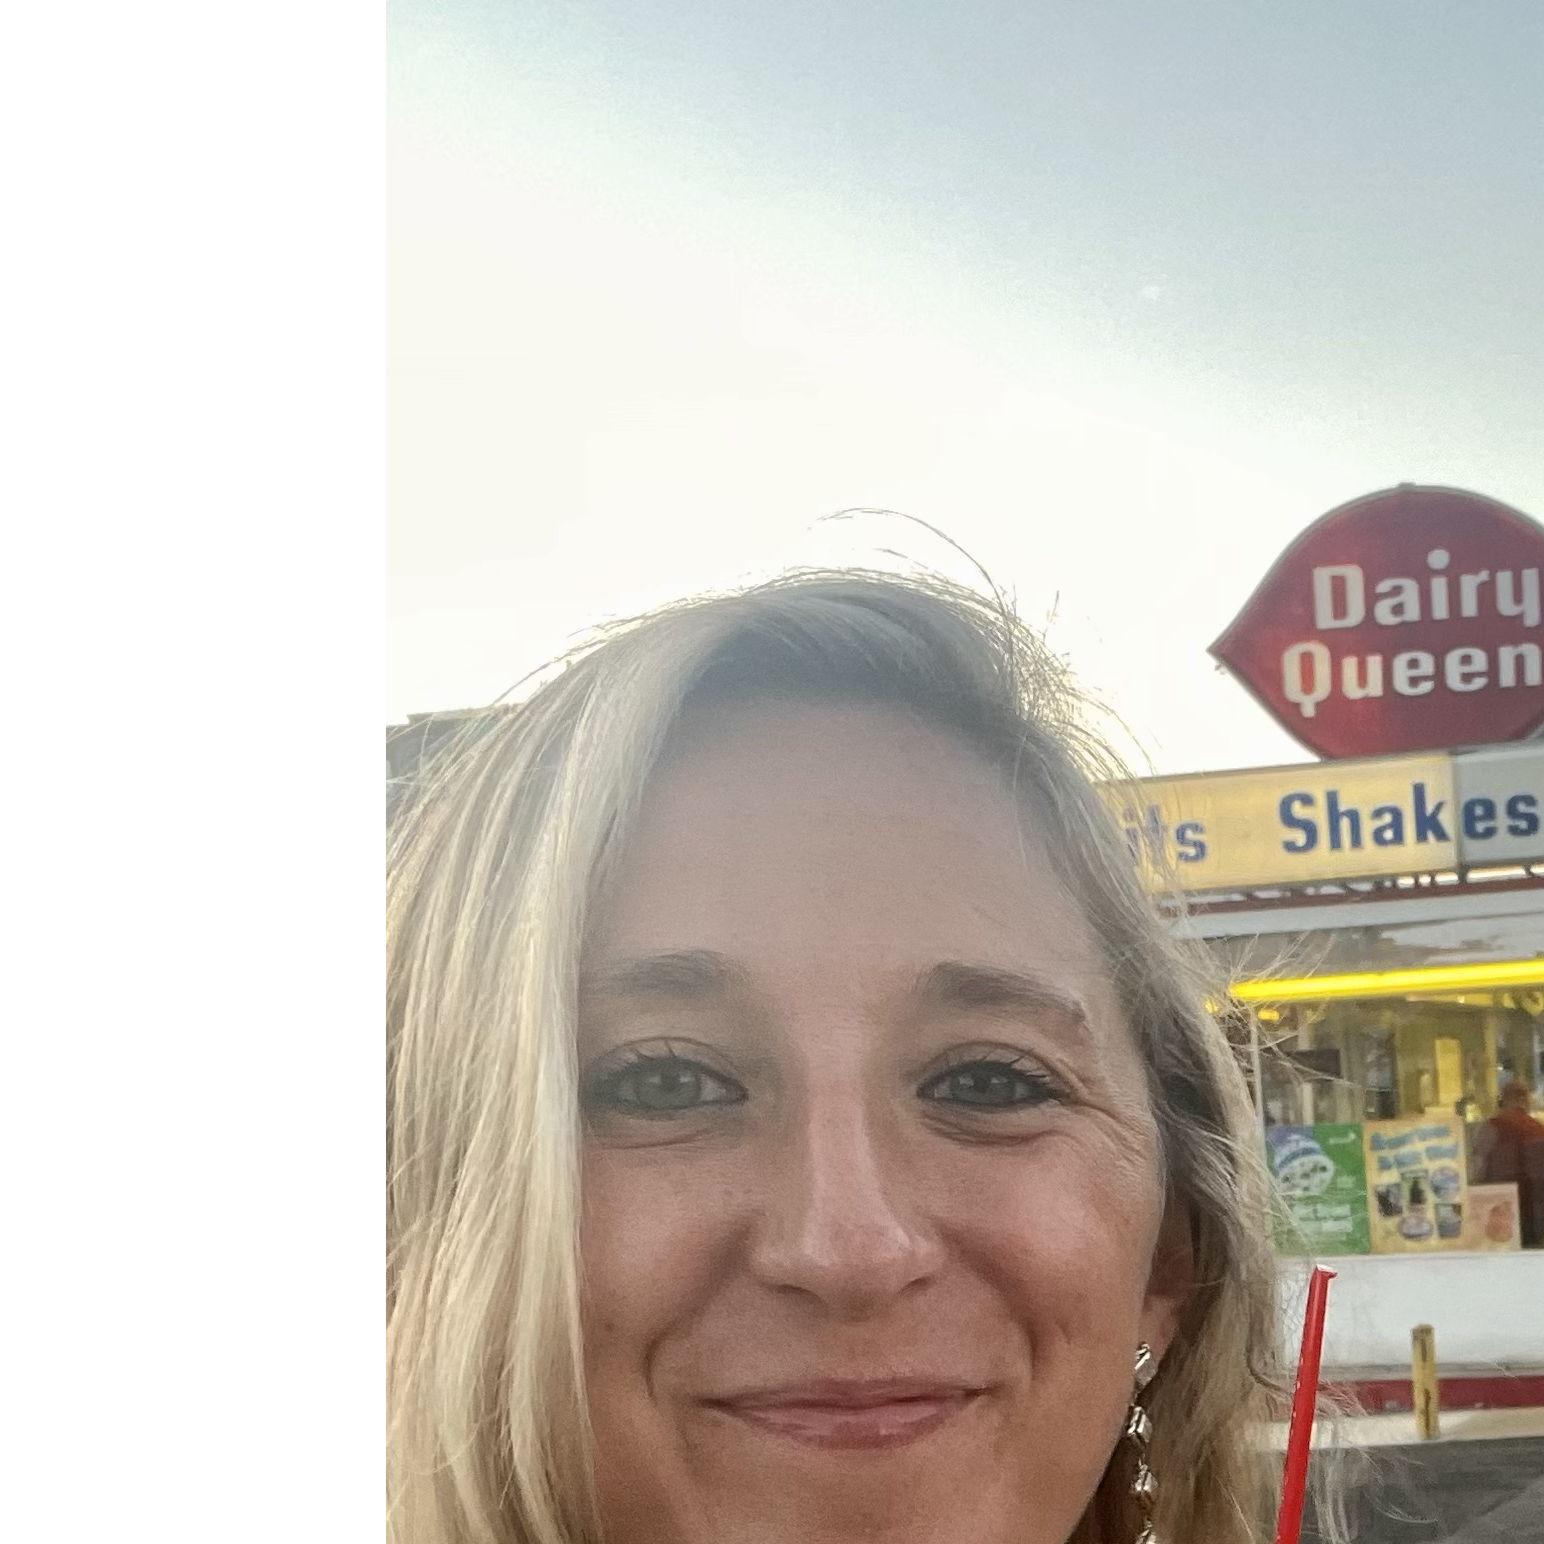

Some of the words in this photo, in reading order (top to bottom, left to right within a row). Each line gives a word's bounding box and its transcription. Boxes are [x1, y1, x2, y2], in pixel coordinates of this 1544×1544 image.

[1312, 548, 1542, 632] Dairy
[1282, 638, 1543, 718] Queen
[1279, 781, 1541, 854] Shakes
